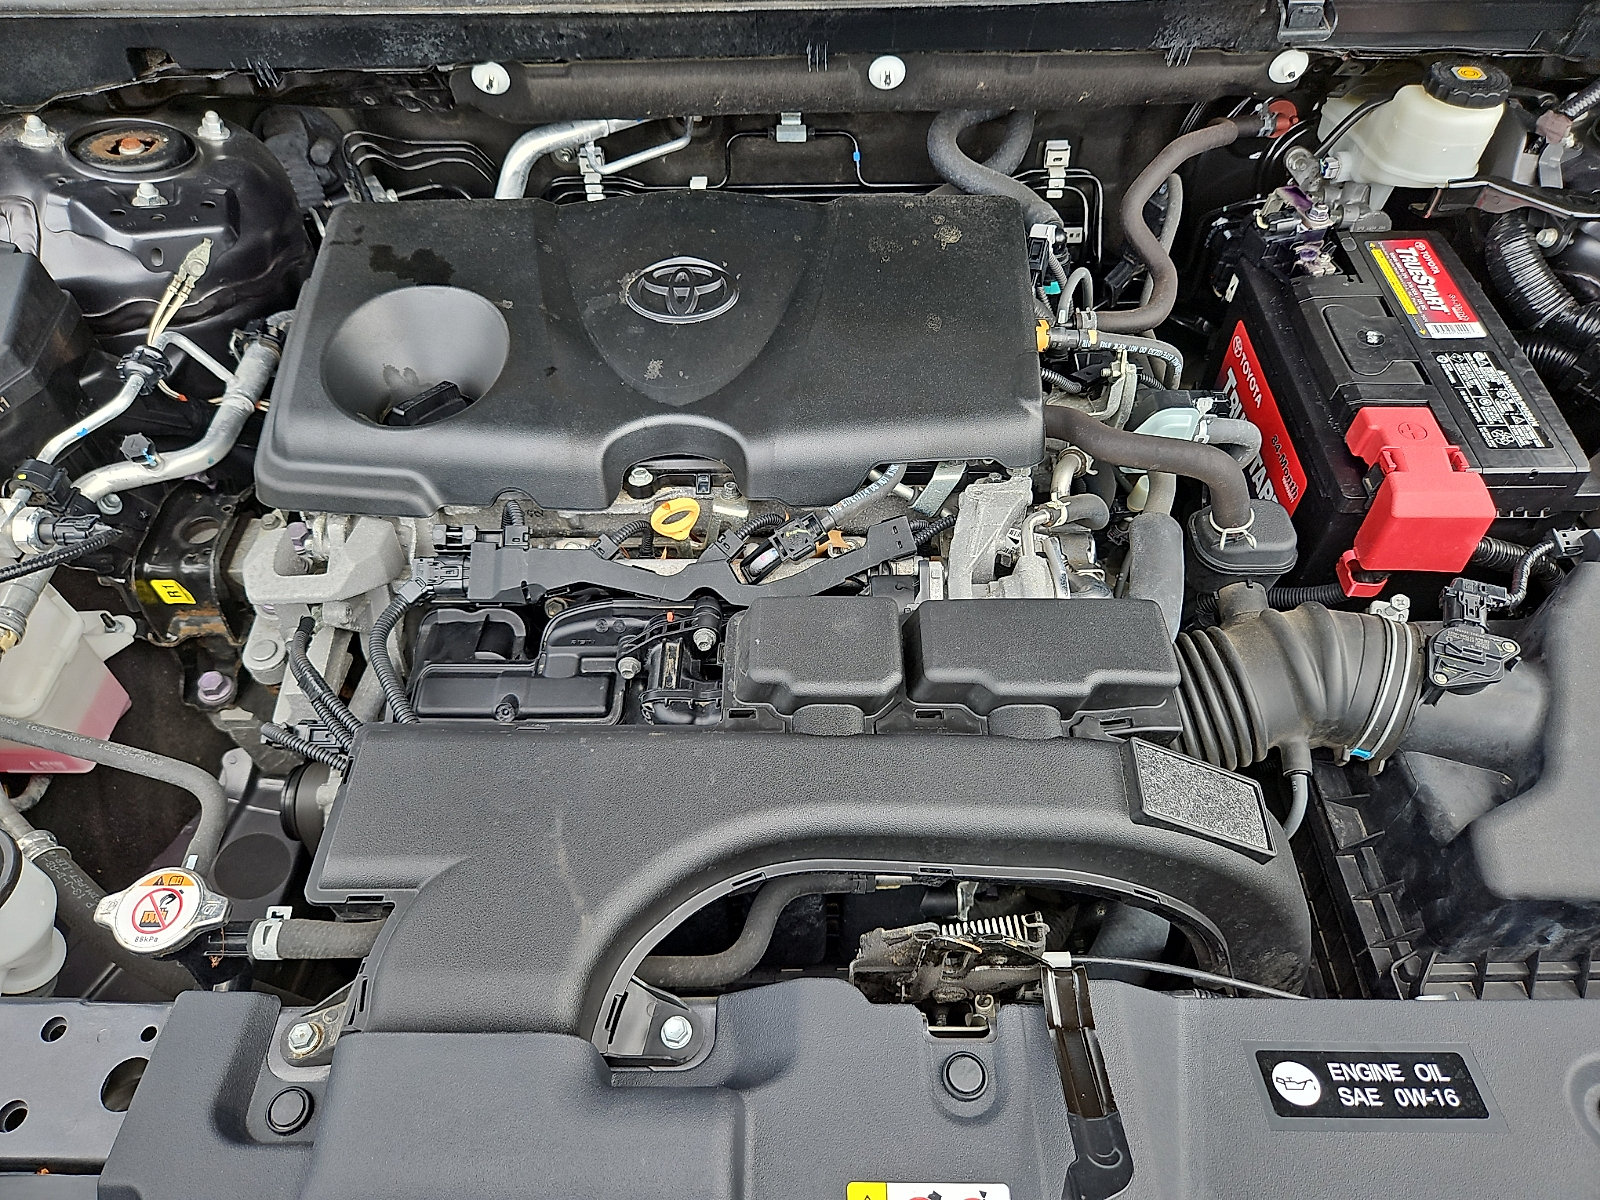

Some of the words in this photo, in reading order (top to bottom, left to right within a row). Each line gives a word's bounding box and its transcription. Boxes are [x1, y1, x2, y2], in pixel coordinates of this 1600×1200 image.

[1420, 249, 1441, 275] TOYOTA
[1239, 356, 1262, 409] TOYOTA
[162, 584, 182, 597] R1
[1326, 1062, 1406, 1082] ENGINE
[1413, 1062, 1451, 1082] OIL
[1337, 1086, 1384, 1107] SAE
[1394, 1087, 1461, 1107] 0W-16
